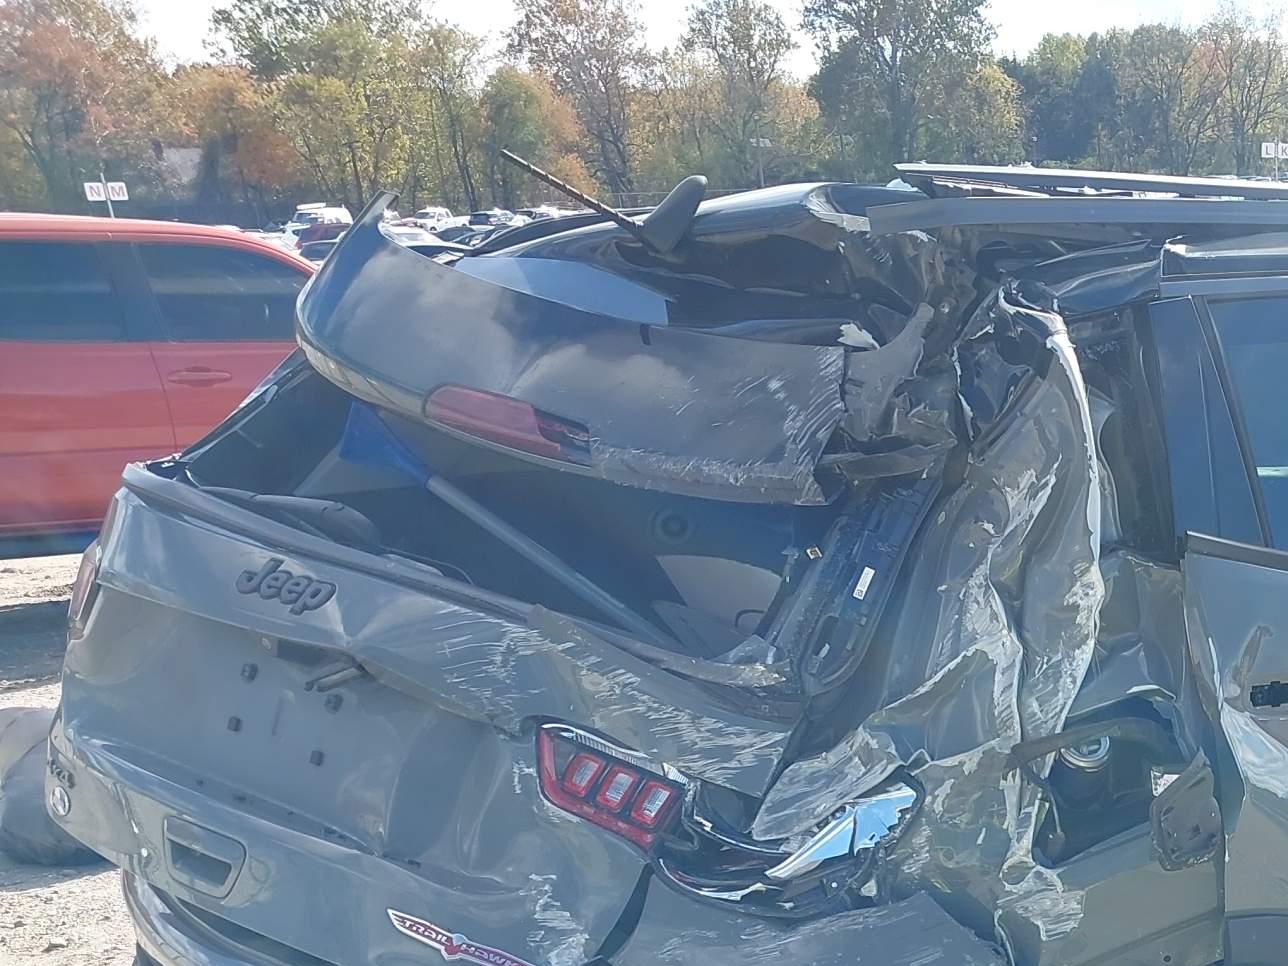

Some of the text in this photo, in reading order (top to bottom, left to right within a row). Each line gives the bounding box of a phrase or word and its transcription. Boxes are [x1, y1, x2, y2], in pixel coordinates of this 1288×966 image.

[1265, 145, 1273, 156] L
[1281, 145, 1288, 157] K
[89, 185, 102, 198] N
[110, 184, 126, 198] M
[235, 557, 337, 616] Jeep
[402, 919, 451, 946] TRAIL
